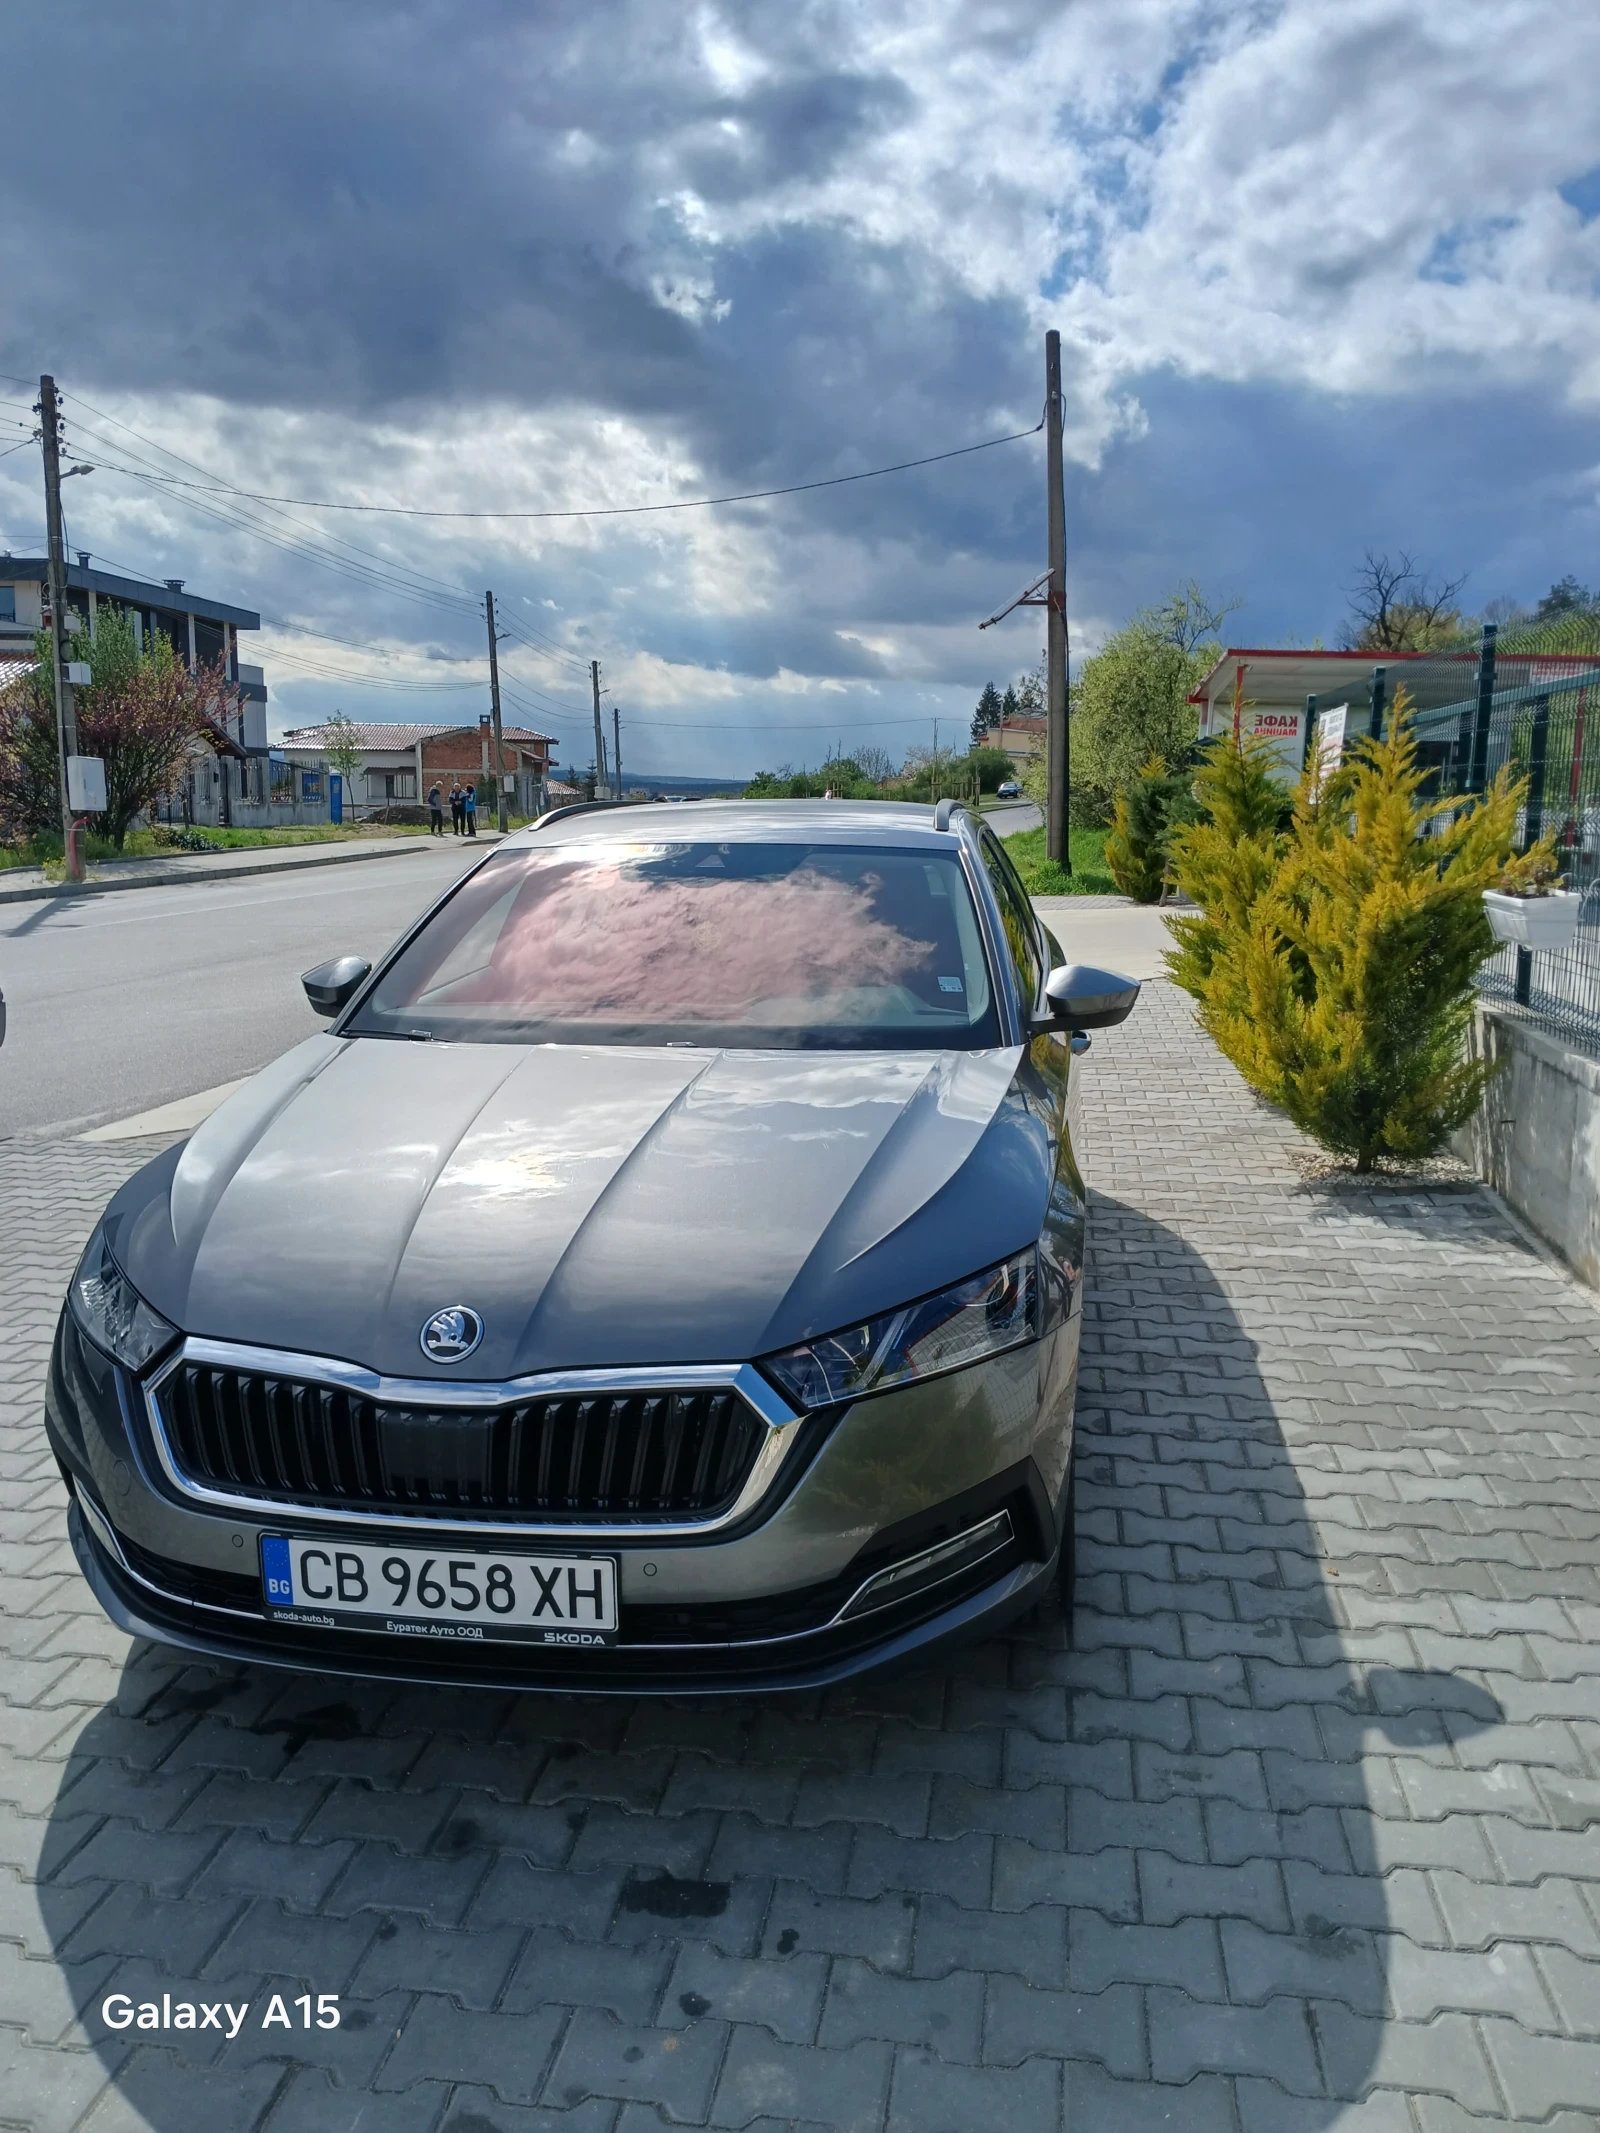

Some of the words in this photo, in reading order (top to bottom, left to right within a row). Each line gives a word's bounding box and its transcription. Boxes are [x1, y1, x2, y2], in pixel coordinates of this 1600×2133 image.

[268, 1578, 290, 1594] BG
[300, 1549, 368, 1602] CB
[381, 1557, 516, 1614] 9658
[529, 1565, 604, 1620] XH
[273, 1610, 335, 1626] skoda-auto.bg
[386, 1620, 428, 1634] Еуратек
[429, 1624, 456, 1636] Ауто
[457, 1626, 484, 1639] ООД
